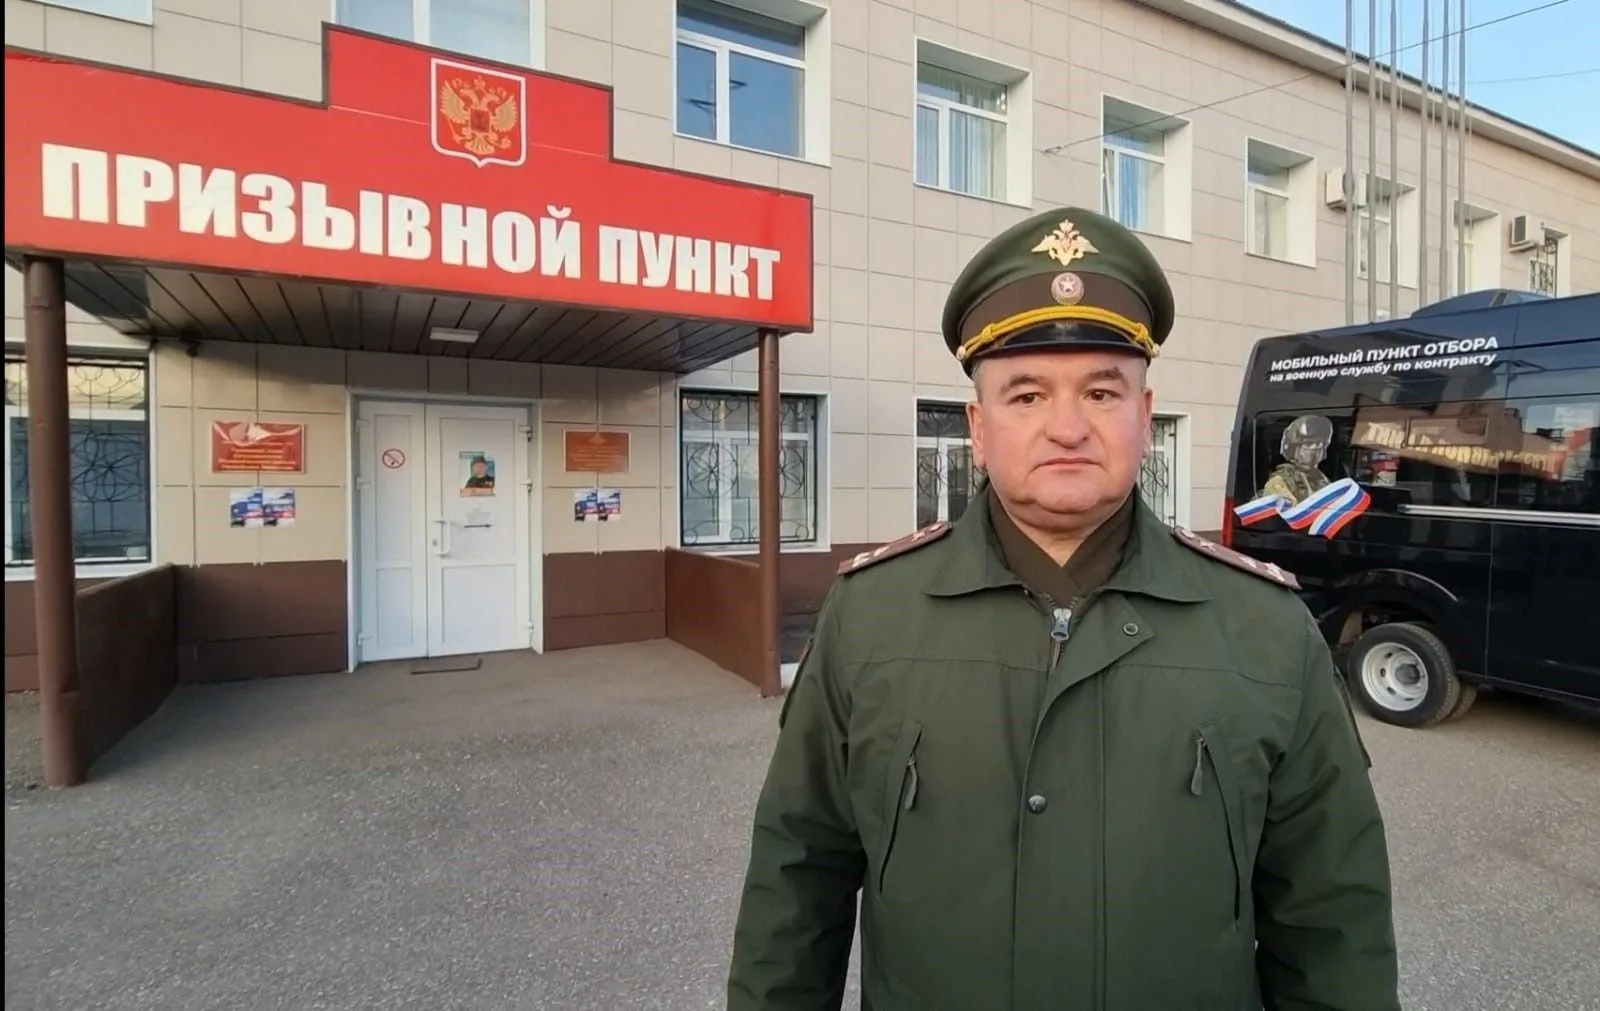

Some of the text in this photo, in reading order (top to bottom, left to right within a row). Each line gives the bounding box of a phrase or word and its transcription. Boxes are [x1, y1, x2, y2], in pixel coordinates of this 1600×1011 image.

[41, 143, 781, 300] ПРИЗЫВНОЙ ПУНКТ
[1269, 353, 1497, 383] на военную службу по контракту
[1270, 336, 1499, 371] МОБИЛЬНЫЙ ПУНКТ ОТБОРА
